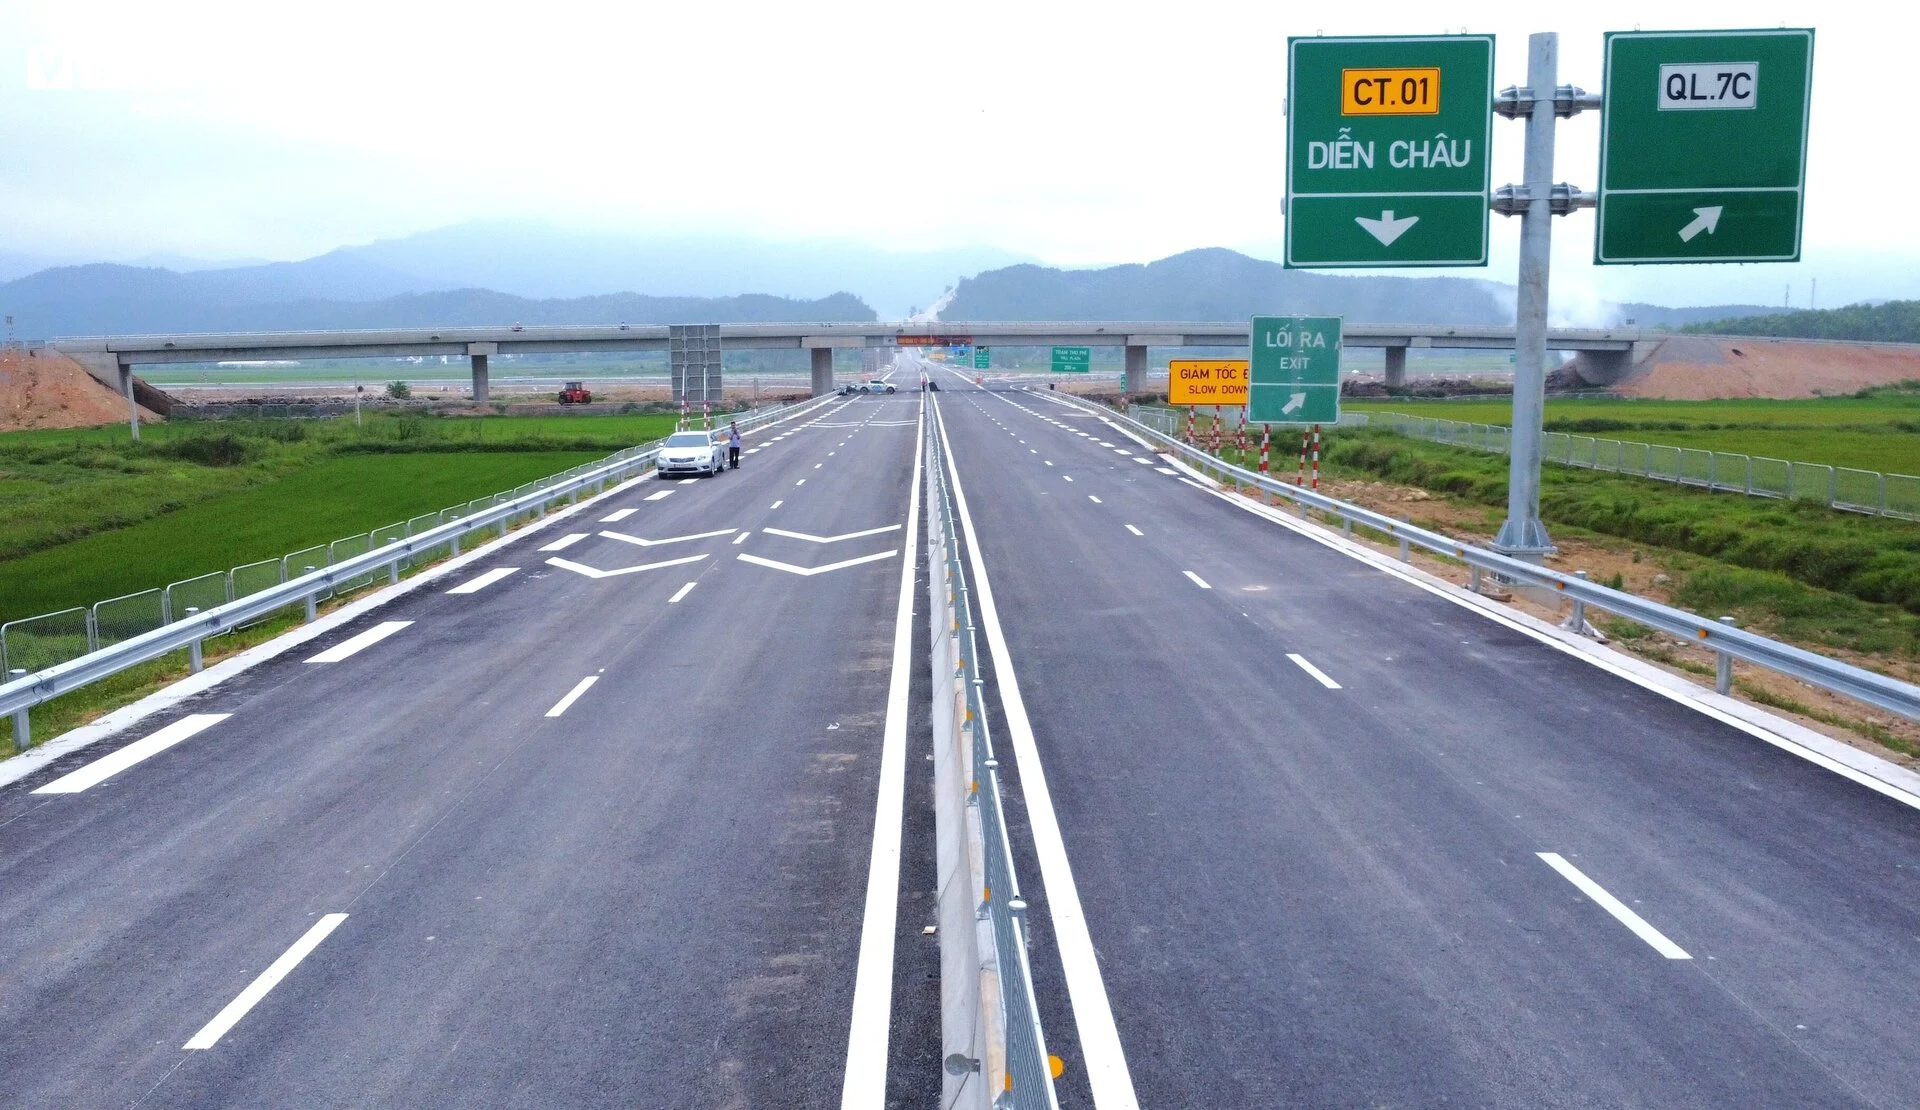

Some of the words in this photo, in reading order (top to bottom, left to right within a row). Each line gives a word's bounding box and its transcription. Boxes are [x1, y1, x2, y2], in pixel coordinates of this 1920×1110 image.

[1353, 78, 1429, 106] CT.01
[1665, 72, 1751, 101] QL.7C
[1308, 126, 1374, 169] DIỄN
[1389, 132, 1471, 169] CHÂU
[1266, 324, 1292, 348] LỐI
[1300, 331, 1326, 348] RA
[1180, 364, 1210, 380] GIẢM
[1215, 363, 1237, 380] TỐC
[1280, 357, 1311, 370] EXIT
[1188, 385, 1217, 394] SLOW
